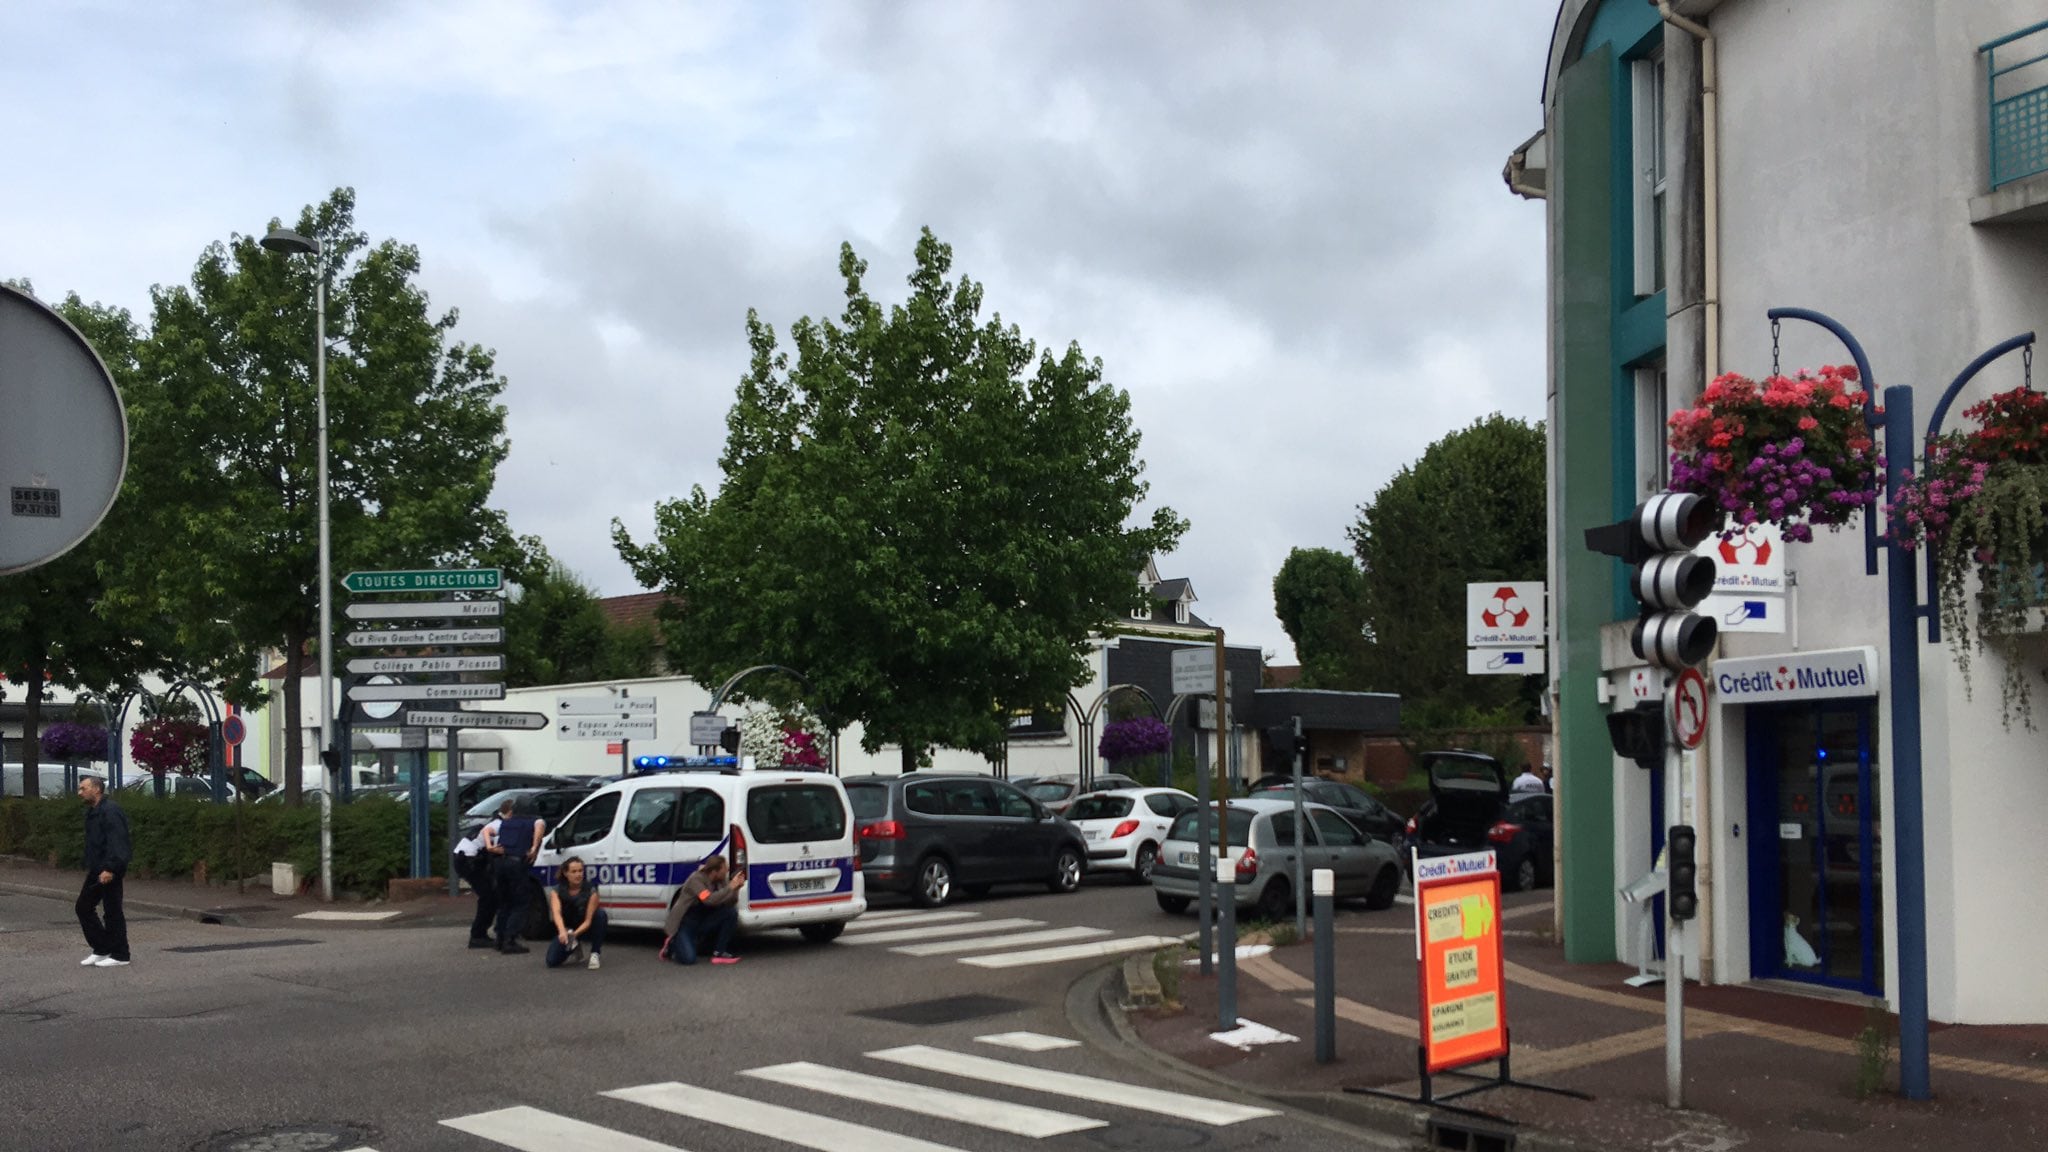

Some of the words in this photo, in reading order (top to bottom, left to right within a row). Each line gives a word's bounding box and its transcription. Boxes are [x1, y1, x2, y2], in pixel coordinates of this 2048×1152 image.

[357, 575, 406, 588] TOUTES
[415, 573, 495, 586] DIRECTIONS
[1751, 575, 1780, 586] Mutuel
[463, 605, 498, 614] Mairie
[353, 635, 365, 644] Le
[368, 634, 387, 643] Rive
[391, 633, 425, 643] Gauche
[428, 632, 458, 642] Centre
[462, 631, 498, 641] Culturel
[1474, 634, 1499, 643] Crédit
[1509, 633, 1537, 642] Mutuel
[421, 659, 451, 669] Pablo
[457, 658, 498, 668] Picasso
[1718, 671, 1774, 694] Crédit
[1797, 663, 1866, 689] Mutuel
[426, 687, 499, 697] Commissariat
[451, 714, 492, 726] Georges
[786, 858, 827, 871] POLICE
[1457, 857, 1487, 872] Mutuel
[586, 864, 657, 884] POLICE
